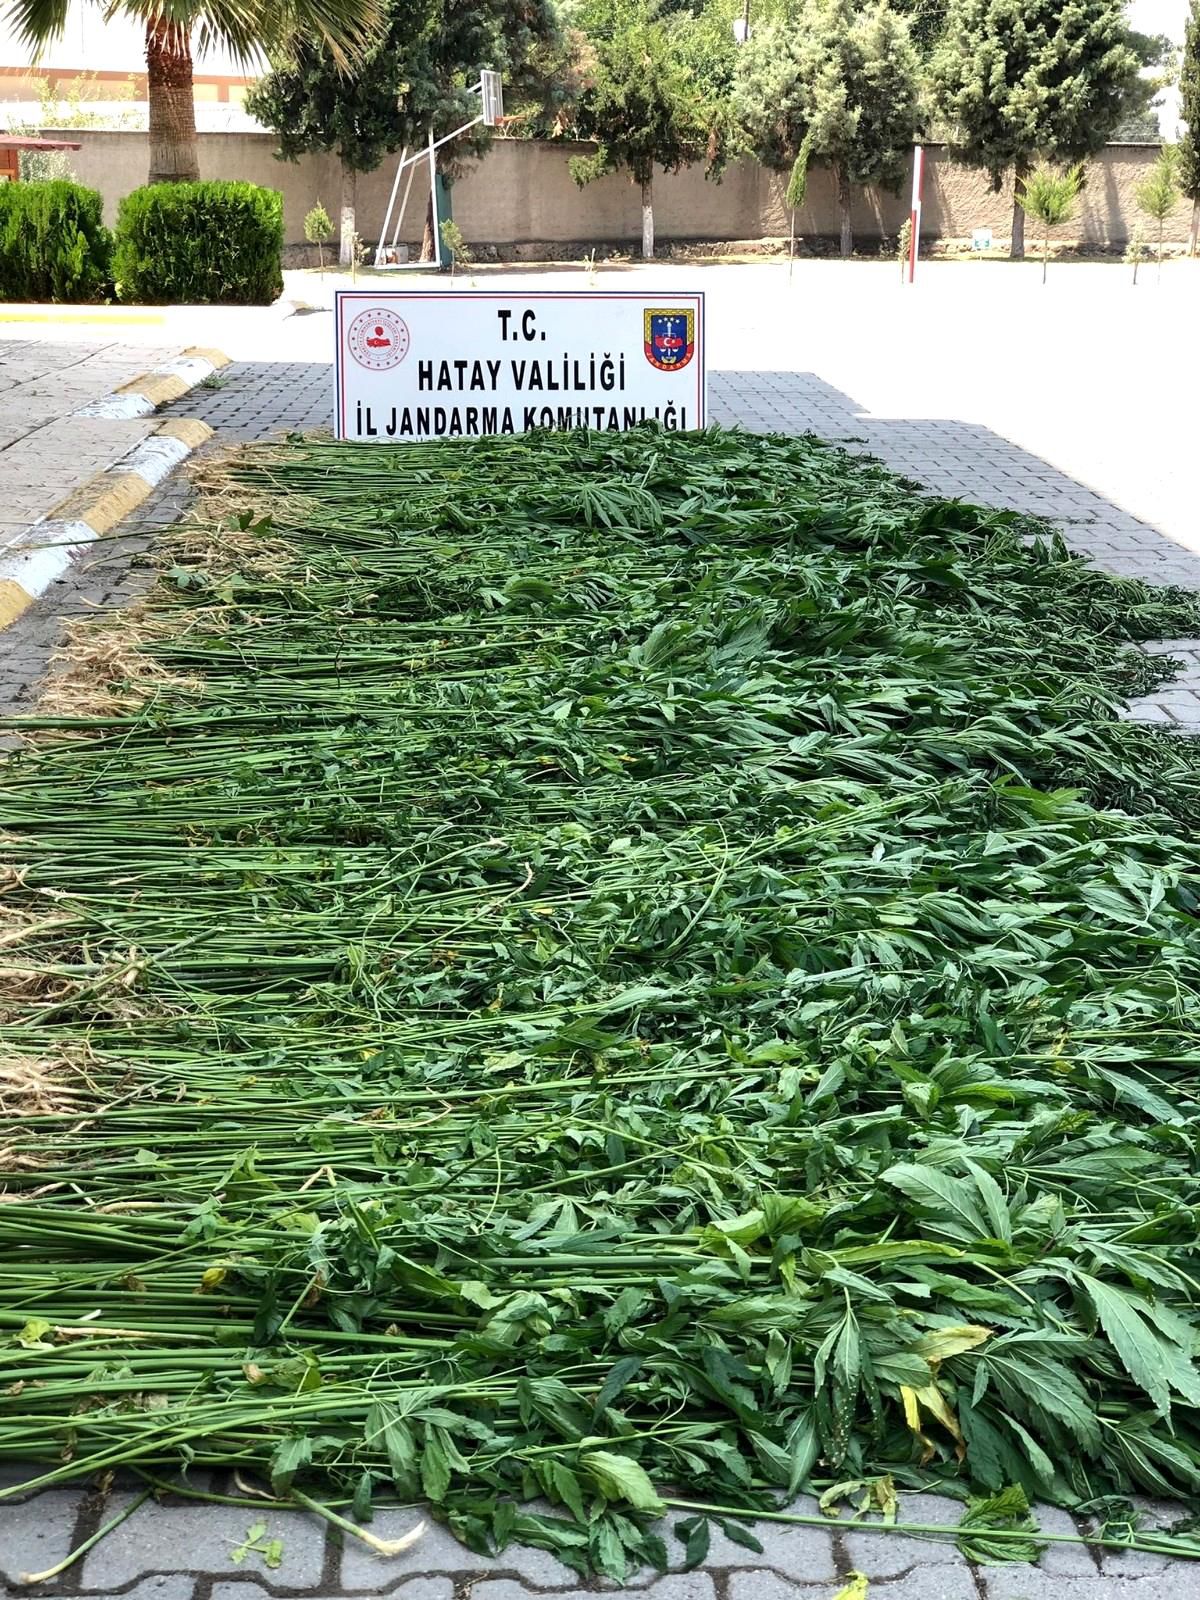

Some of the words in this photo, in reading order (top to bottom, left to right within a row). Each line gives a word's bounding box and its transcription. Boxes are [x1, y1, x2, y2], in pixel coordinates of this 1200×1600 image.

[497, 309, 546, 342] T.C.
[418, 360, 501, 391] HATAY
[511, 352, 624, 391] VALİLİĞİ
[356, 400, 378, 435] İL
[386, 407, 514, 435] JANDARMA
